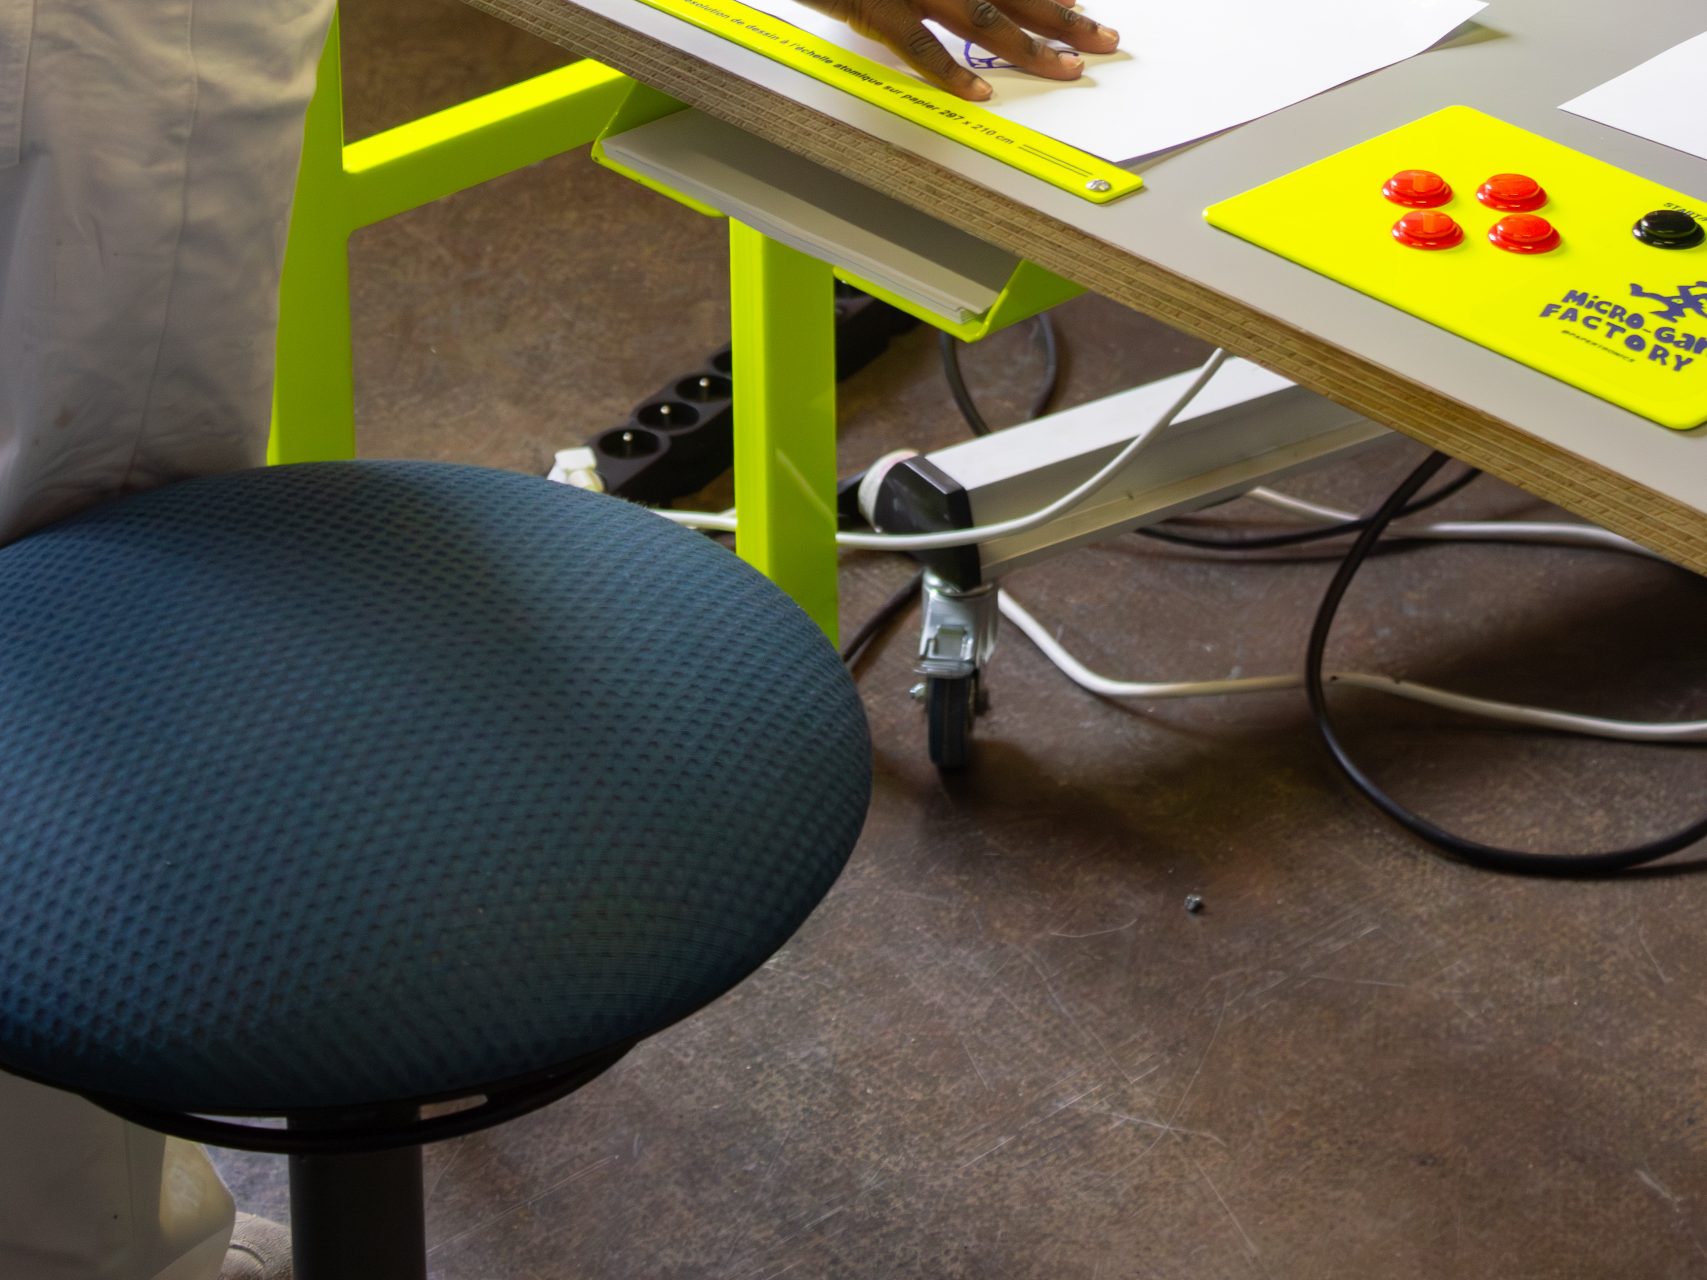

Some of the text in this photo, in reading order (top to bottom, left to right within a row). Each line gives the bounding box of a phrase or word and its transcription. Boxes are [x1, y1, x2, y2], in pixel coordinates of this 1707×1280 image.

[745, 24, 780, 40] dessin
[833, 63, 883, 86] atomique
[883, 85, 904, 95] sur
[900, 94, 941, 111] papier
[938, 109, 965, 121] 297
[971, 123, 997, 136] 210
[995, 135, 1015, 145] cm
[1539, 303, 1693, 372] FACTORY
